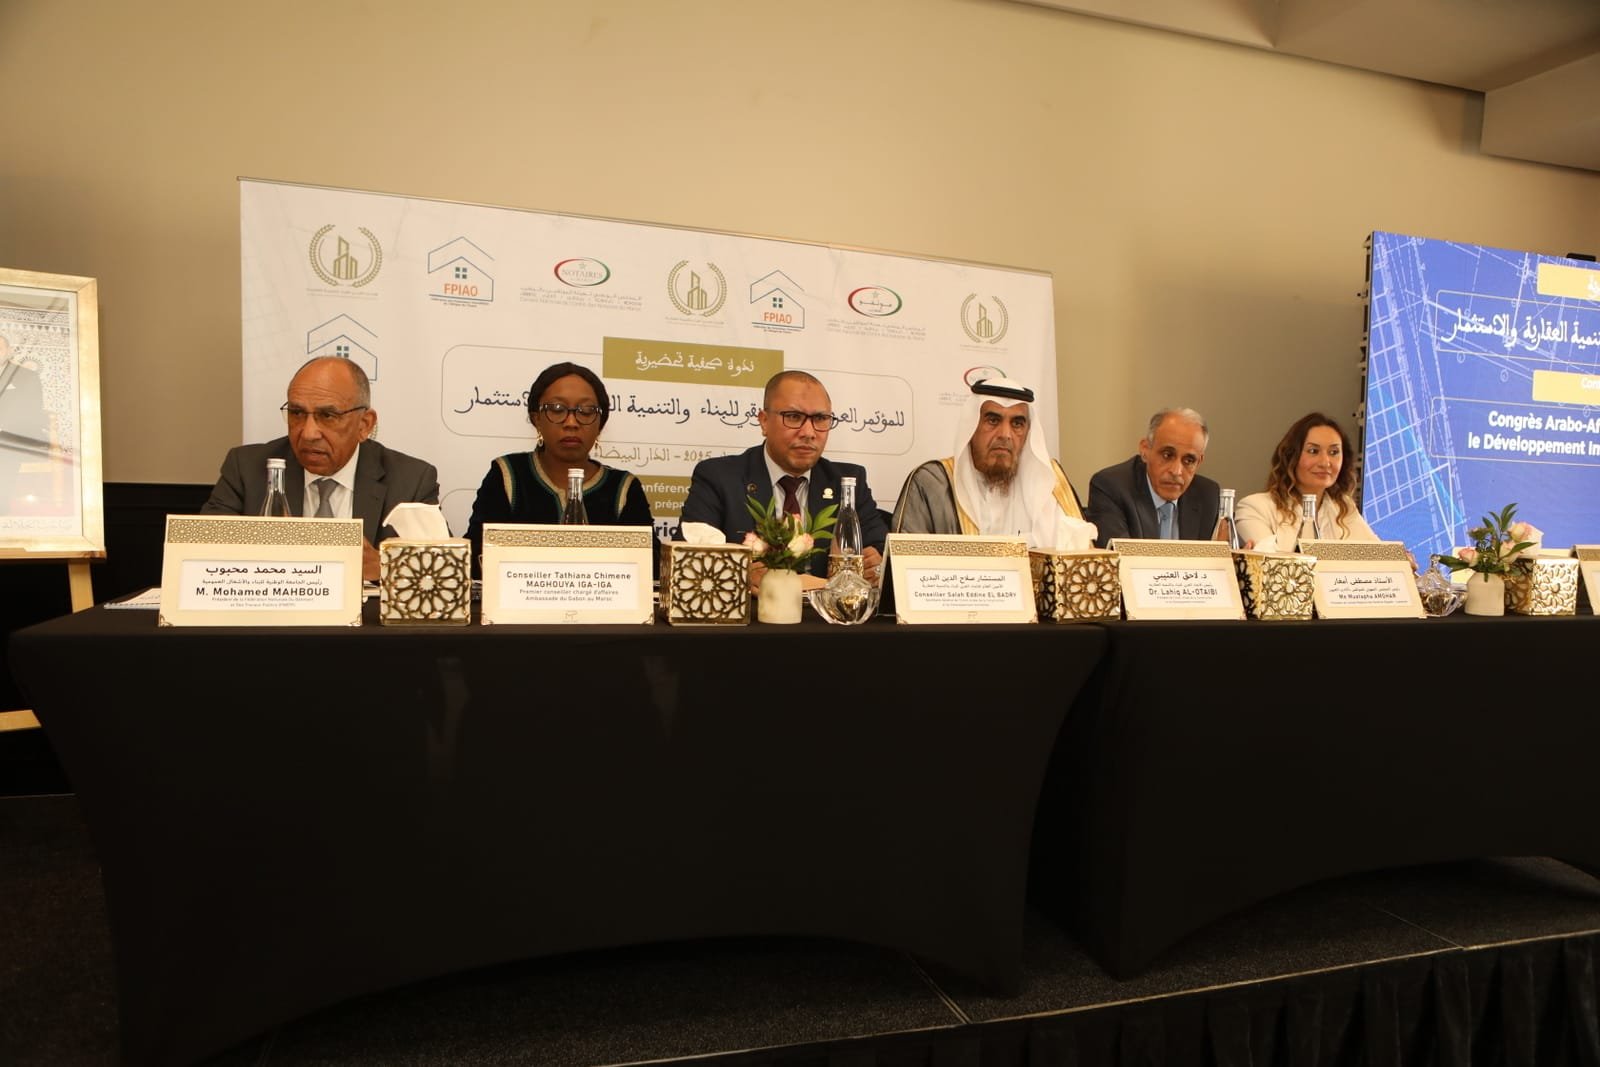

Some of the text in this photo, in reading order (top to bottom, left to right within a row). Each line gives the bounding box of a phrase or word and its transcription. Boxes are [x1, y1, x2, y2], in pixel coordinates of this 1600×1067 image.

[444, 283, 479, 298] FPIAO
[764, 312, 793, 325] FPIAO
[1523, 316, 1568, 351] العقارية
[727, 358, 754, 377] ندوة
[627, 394, 691, 424] والتنمية
[701, 399, 739, 420] للبناء
[851, 410, 905, 434] للمؤتمر
[1488, 410, 1600, 435] Congrès Arabo-Af
[1468, 432, 1481, 449] le
[1483, 433, 1586, 458] Développement
[205, 564, 321, 577] السيد محمد محبوب
[507, 571, 632, 580] Conseiller Tathiana Chimene
[196, 587, 330, 597] M. Mohamed MAHBOUB
[526, 580, 613, 589] MAGHOUYA IGA-IGA
